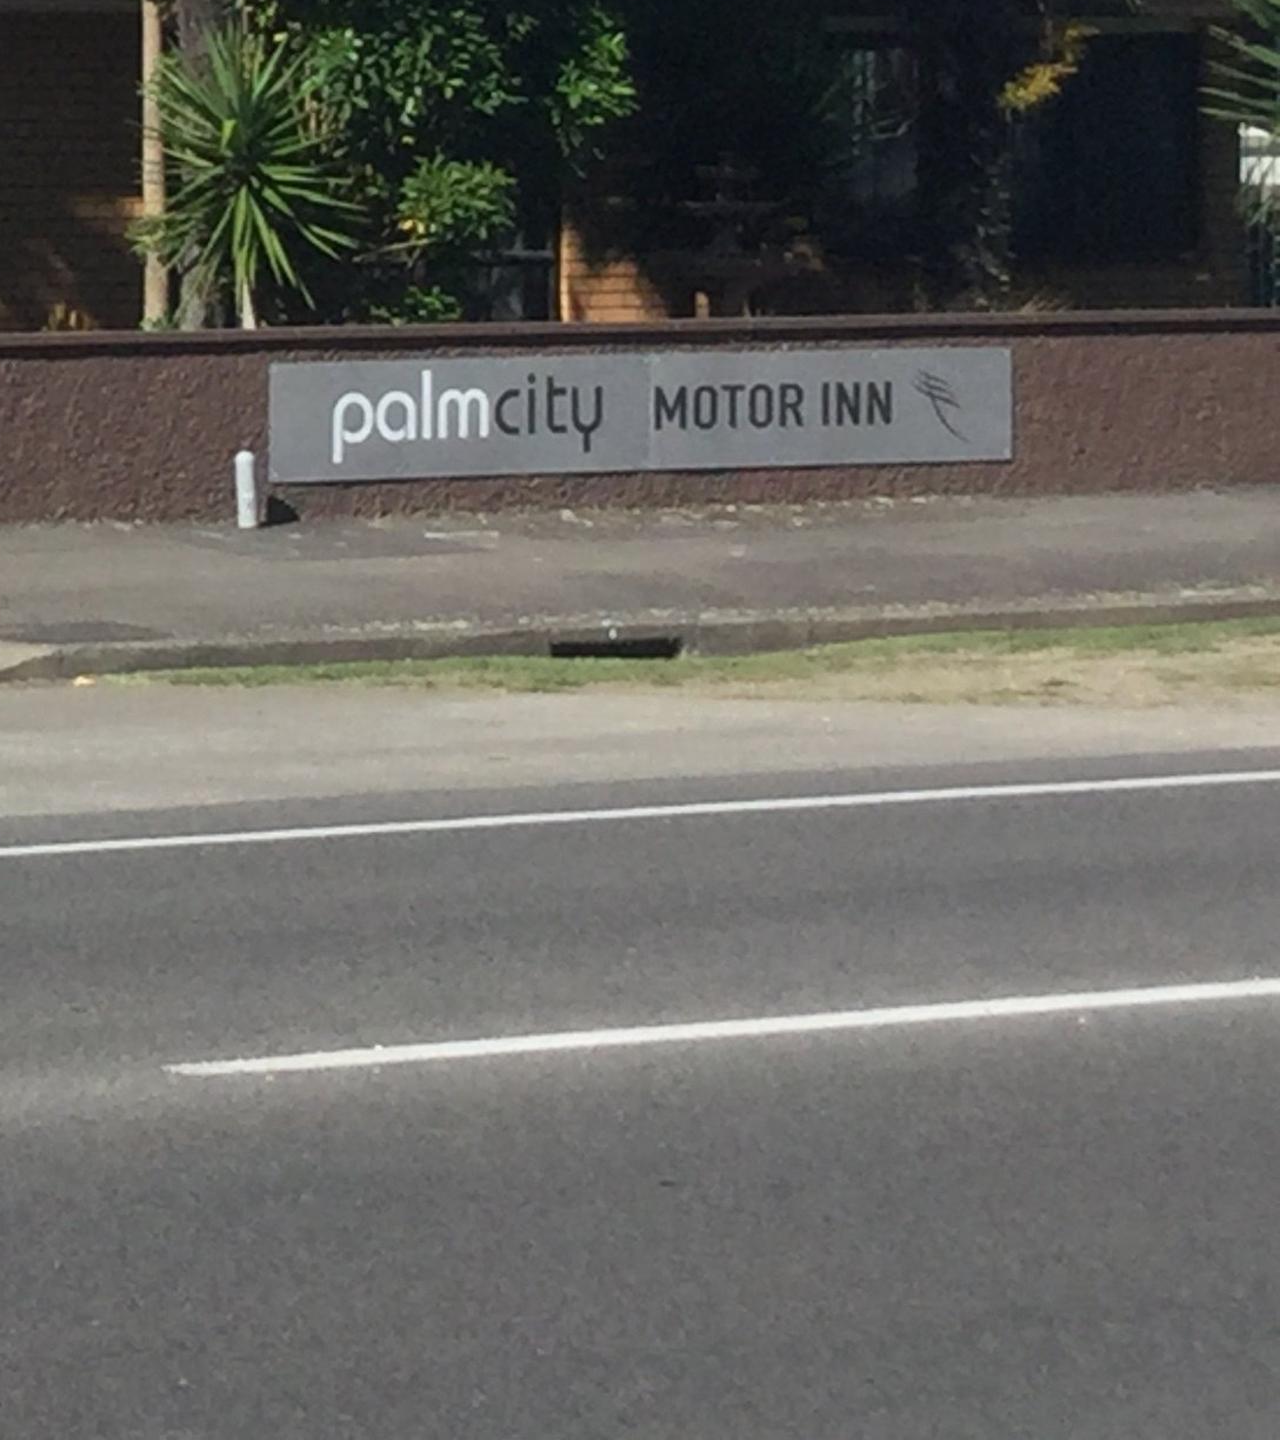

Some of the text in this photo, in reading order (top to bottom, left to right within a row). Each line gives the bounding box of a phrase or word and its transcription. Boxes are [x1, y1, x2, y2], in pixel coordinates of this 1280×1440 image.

[333, 369, 893, 464] palmcity MOTOR INN
